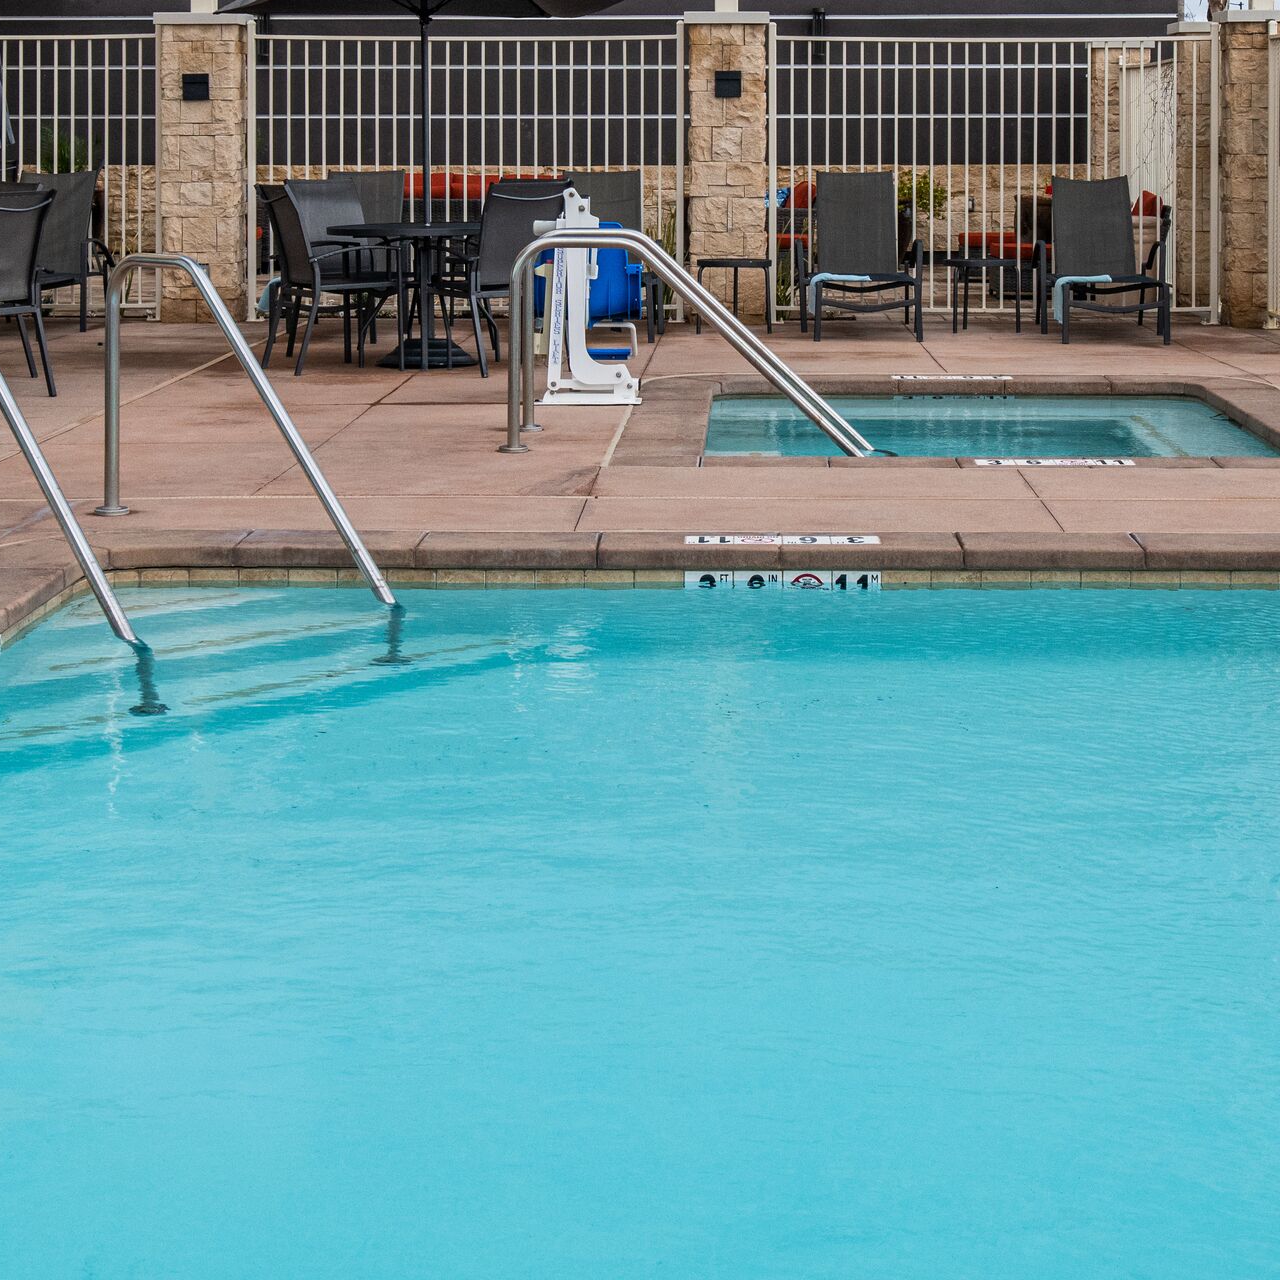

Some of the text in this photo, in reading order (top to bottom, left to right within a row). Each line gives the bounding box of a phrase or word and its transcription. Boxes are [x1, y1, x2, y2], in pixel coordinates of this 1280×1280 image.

[798, 536, 818, 544] 6
[846, 536, 864, 544] 3
[698, 574, 717, 589] 3
[720, 574, 729, 583] FT
[747, 574, 766, 589] 6
[768, 574, 778, 583] IN
[870, 574, 879, 583] M
